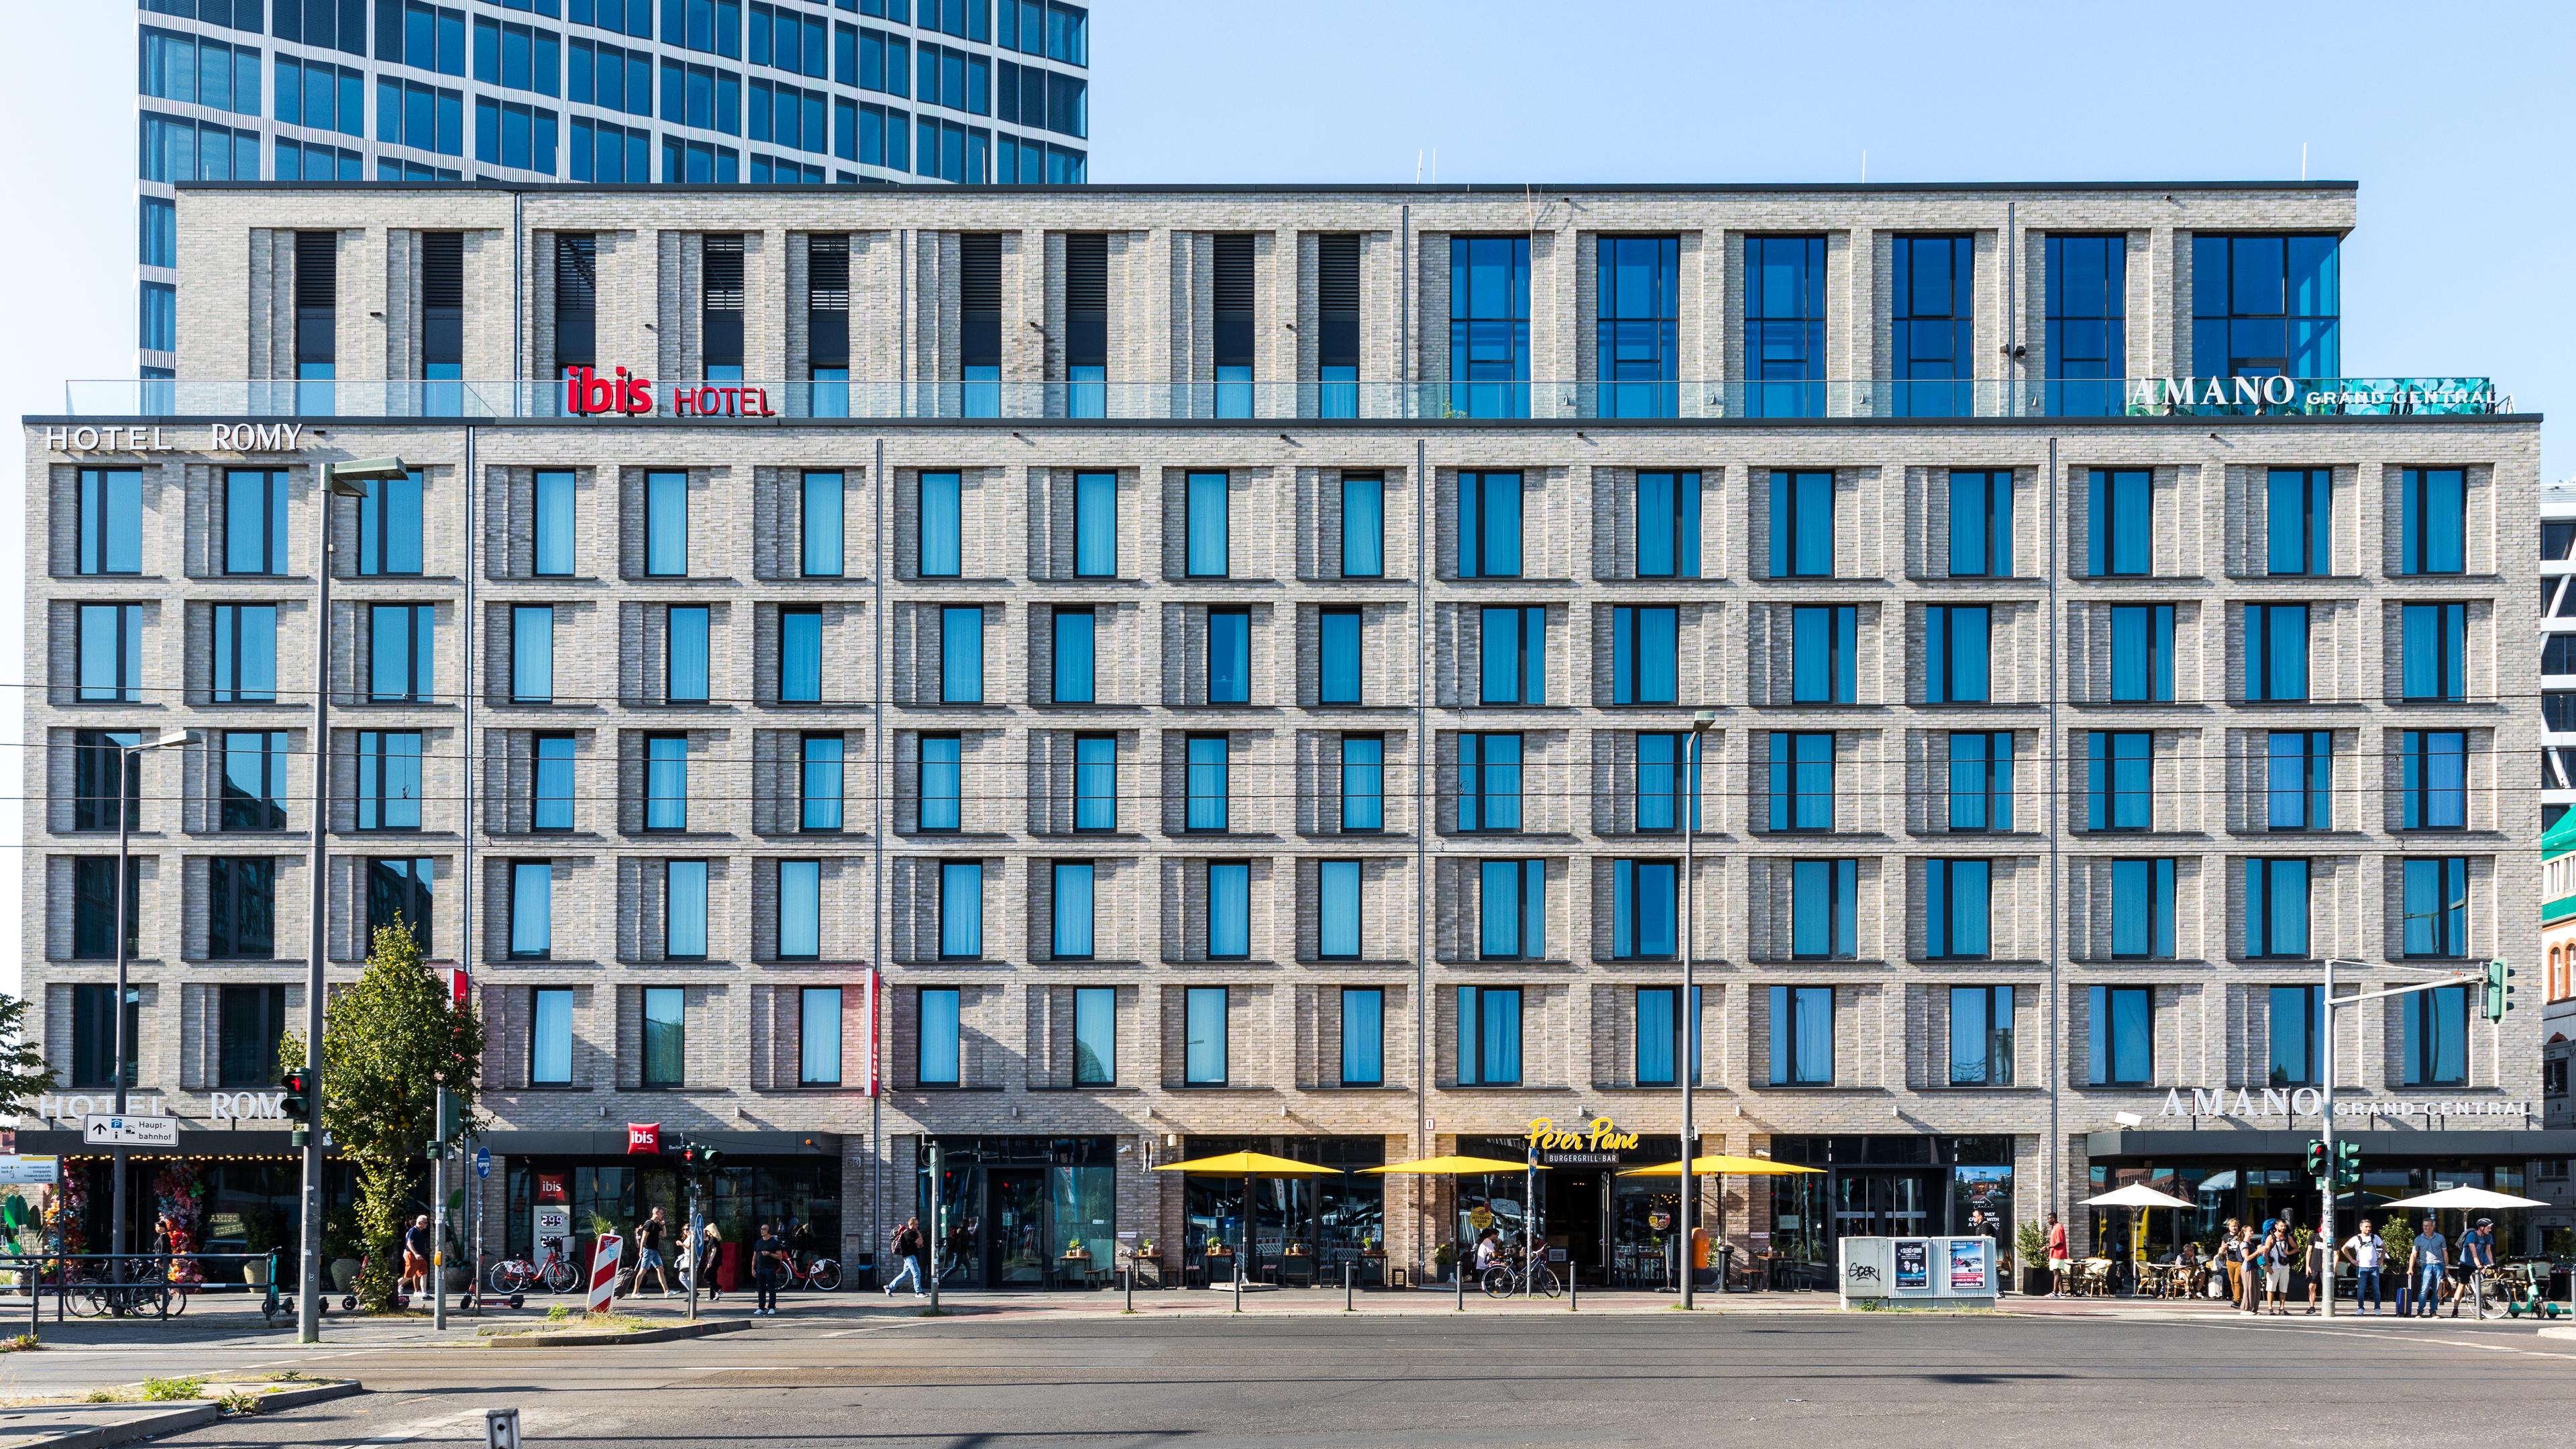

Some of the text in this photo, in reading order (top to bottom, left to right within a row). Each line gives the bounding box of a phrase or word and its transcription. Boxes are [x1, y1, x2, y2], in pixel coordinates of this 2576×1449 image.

[568, 366, 775, 417] ibis HOTEL
[2129, 376, 2496, 405] AMANO GRAND CENTRAL
[46, 423, 302, 451] HOTEL ROMY
[211, 1092, 287, 1120] ROM
[2159, 1087, 2532, 1117] AMANO GRAND CENTRAL
[138, 1121, 166, 1130] Haupt-
[138, 1132, 172, 1140] bahnhof
[1524, 1117, 1639, 1152] Peter Pane
[631, 1130, 653, 1144] ibis
[542, 1181, 562, 1192] ibis
[215, 1223, 247, 1235] COHEN
[541, 1216, 563, 1226] 299
